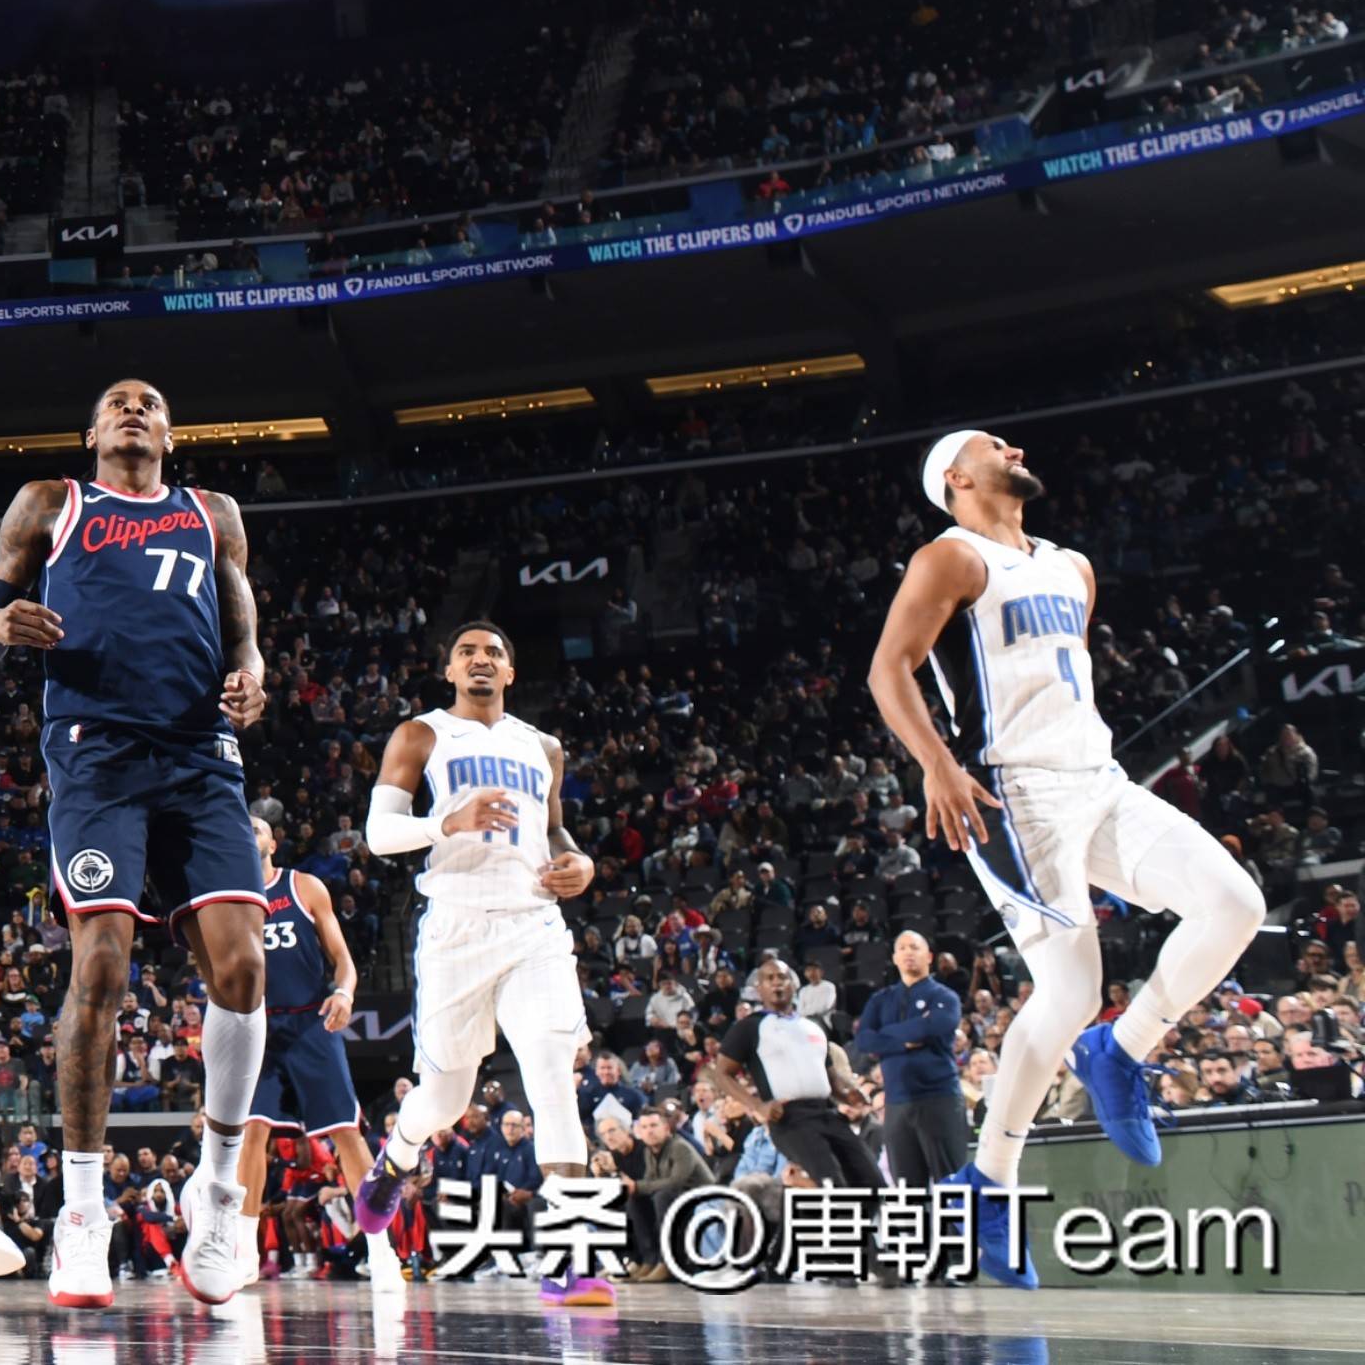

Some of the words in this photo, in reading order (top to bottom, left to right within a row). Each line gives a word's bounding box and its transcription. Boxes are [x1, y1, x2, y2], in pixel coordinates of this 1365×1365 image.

[1043, 150, 1103, 179] WATCH
[1104, 142, 1140, 166] THE
[1140, 123, 1225, 159] CLIPPERS
[1226, 118, 1254, 140] ON
[1288, 91, 1364, 123] FANDUEL
[62, 224, 119, 242] KIA
[588, 240, 642, 264] WATCH
[644, 235, 676, 255] THE
[677, 223, 752, 251] CLIPPERS
[753, 220, 777, 240] ON
[806, 201, 875, 227] FANDUEL
[876, 188, 932, 213] SPORTS
[933, 173, 1006, 201] NETWORK
[163, 292, 214, 311] WATCH
[216, 290, 245, 307] THE
[247, 286, 315, 306] CLIPPERS
[317, 282, 338, 299] ON
[366, 271, 431, 291] FANDUEL
[431, 263, 485, 282] SPORTS
[486, 254, 554, 275] NETWORK
[13, 305, 65, 319] SPORTS
[66, 300, 131, 315] NETWORK
[82, 510, 205, 553] Clippers
[144, 548, 207, 598] 77
[519, 556, 608, 587] KIA
[447, 755, 545, 803] MAGIC
[263, 921, 298, 951] 33
